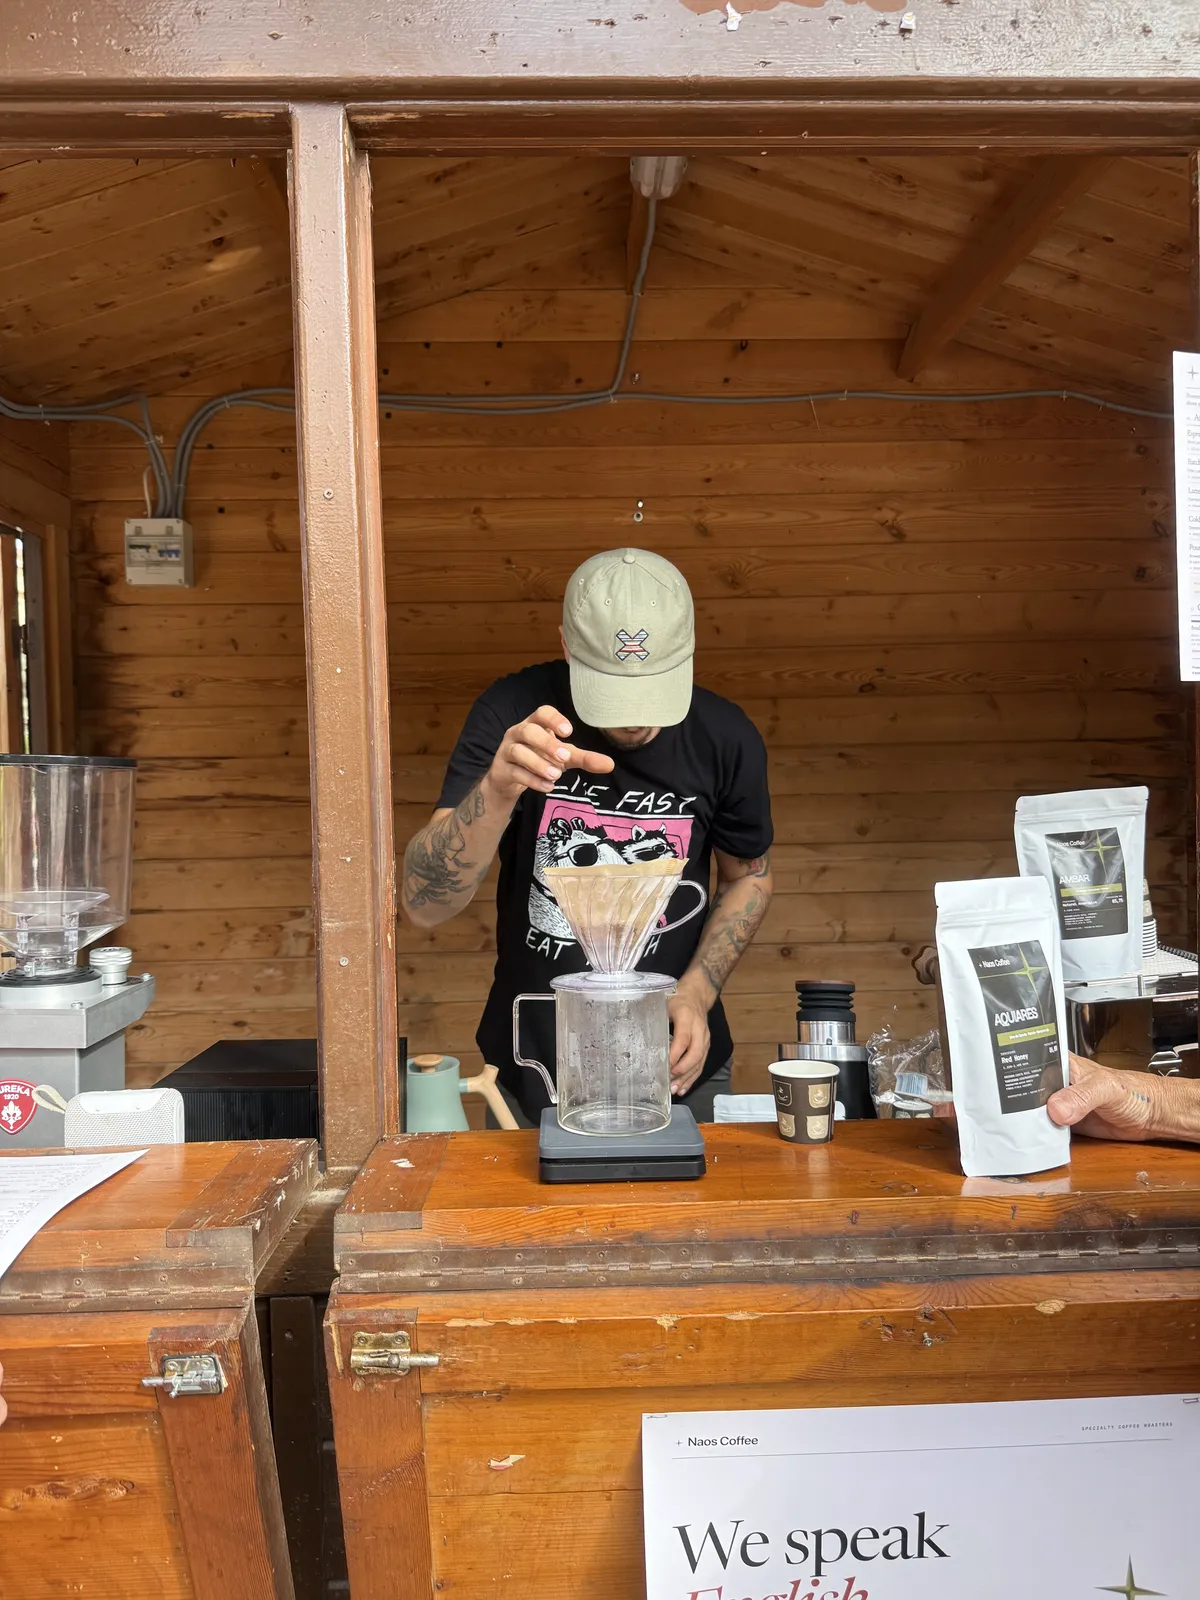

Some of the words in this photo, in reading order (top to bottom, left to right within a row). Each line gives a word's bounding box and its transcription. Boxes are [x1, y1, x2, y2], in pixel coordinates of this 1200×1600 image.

[615, 790, 698, 815] FAST
[525, 926, 577, 961] EAT
[982, 960, 996, 968] Naos
[995, 958, 1011, 967] Coffee
[994, 1006, 1039, 1027] AQUIARES
[1001, 1056, 1013, 1064] Red
[1014, 1053, 1029, 1062] Honey
[0, 1084, 30, 1097] UREKA
[687, 1436, 718, 1447] Naos
[720, 1435, 759, 1446] Coffee
[672, 1520, 770, 1574] We
[785, 1511, 951, 1577] speak
